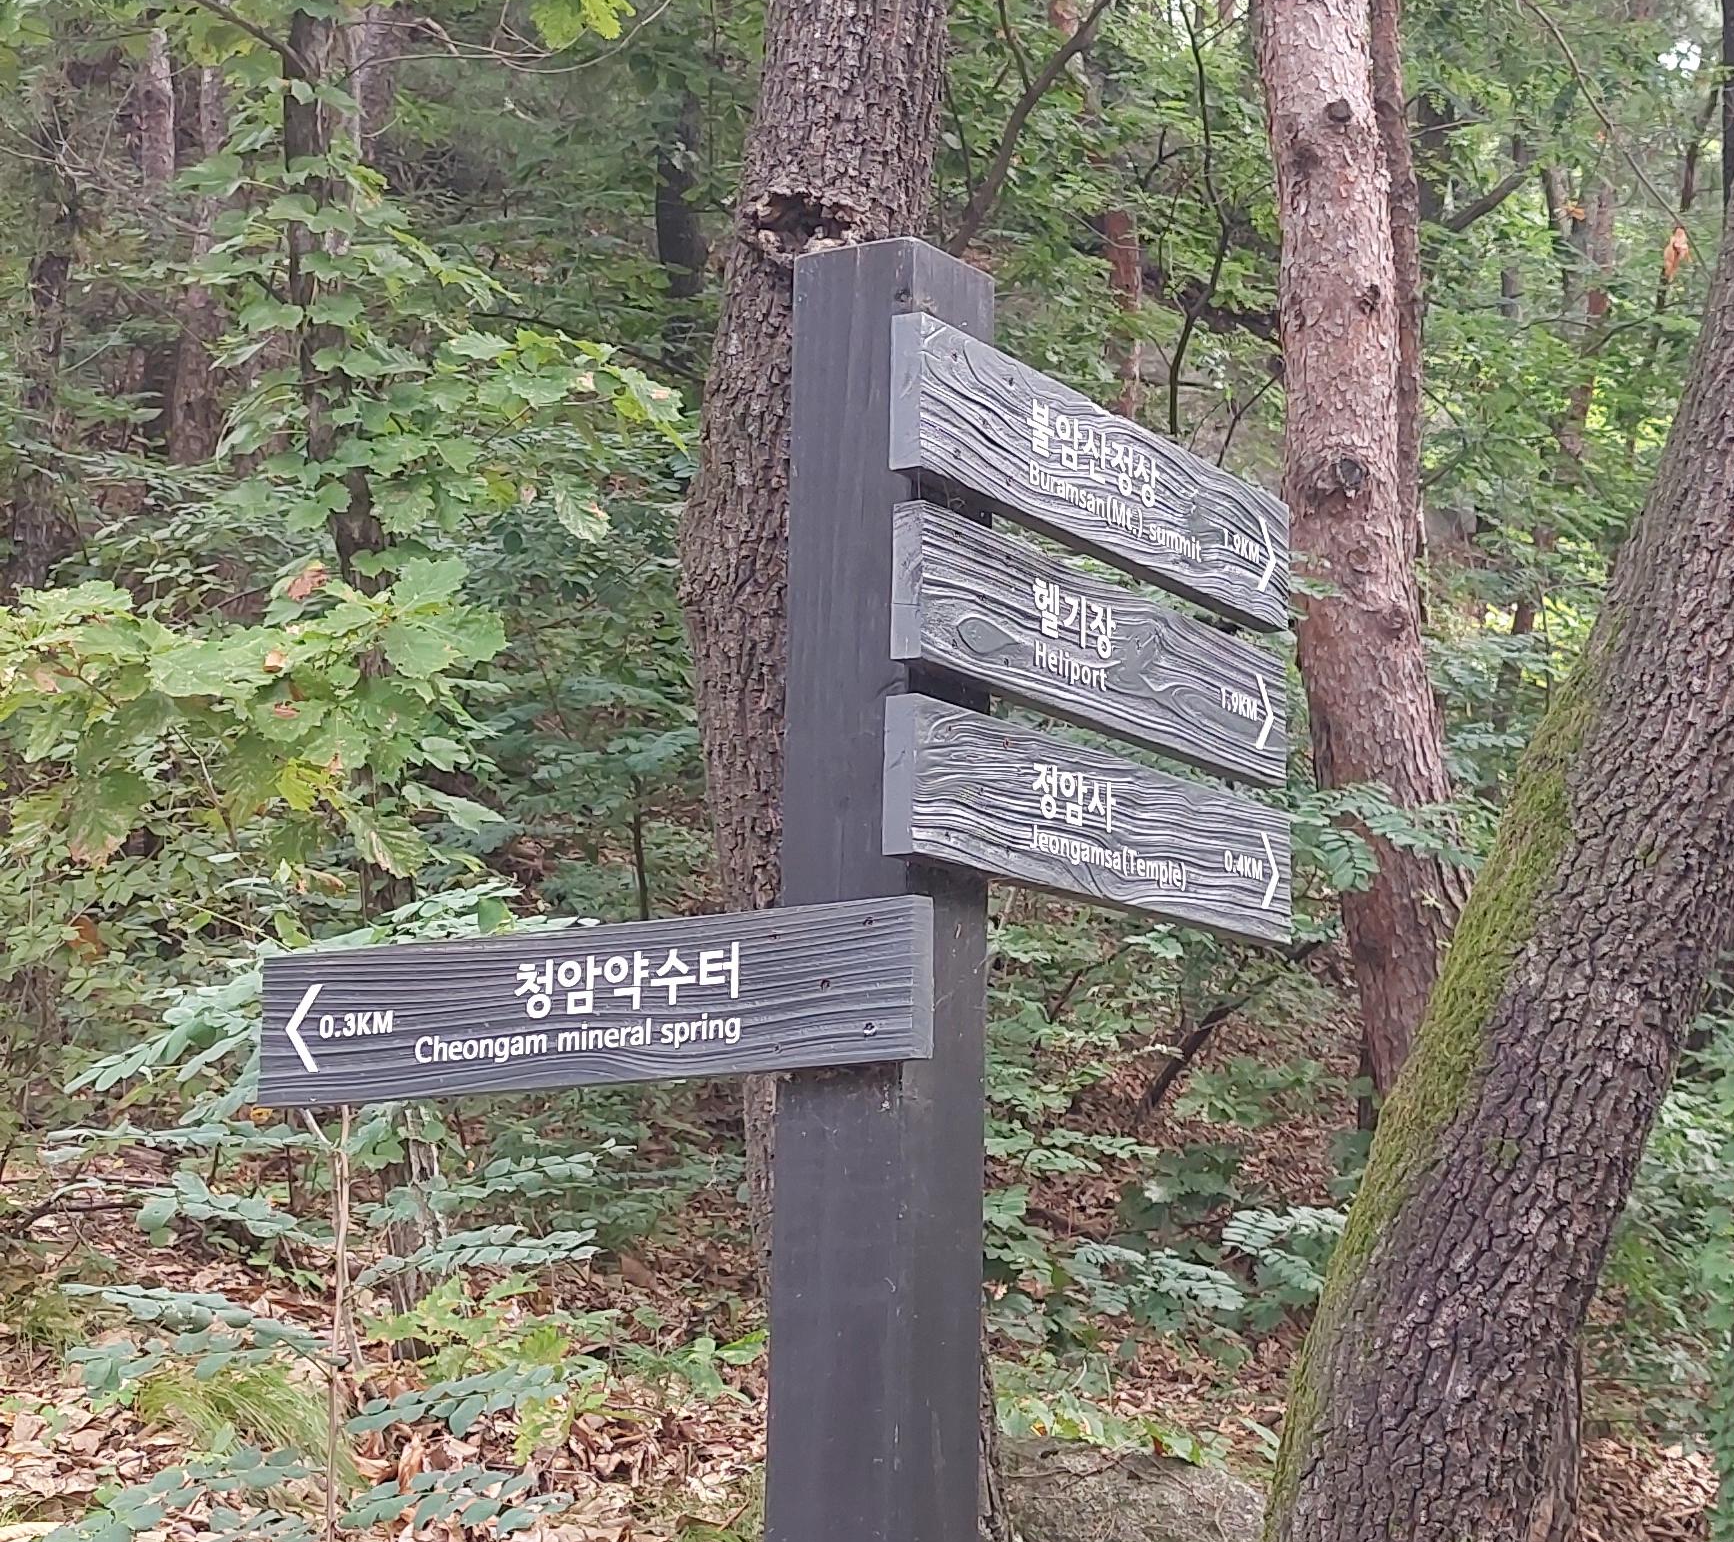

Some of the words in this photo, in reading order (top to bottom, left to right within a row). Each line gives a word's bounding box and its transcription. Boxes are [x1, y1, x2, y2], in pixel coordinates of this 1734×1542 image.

[1026, 398, 1160, 508] 불암산정상
[1029, 459, 1143, 540] Buramsan(Mt.)
[1148, 523, 1202, 563] summit
[1031, 577, 1117, 659] 헬기장
[1033, 639, 1109, 692] Heliport
[1031, 762, 1117, 834] 정암사
[1223, 850, 1264, 882] 0.4KM
[514, 941, 742, 1019] 청암약수터
[318, 1009, 395, 1040] 0.3KM
[413, 1033, 549, 1066] Cheongam
[556, 1017, 653, 1053] mineral
[660, 1015, 742, 1051] spring
